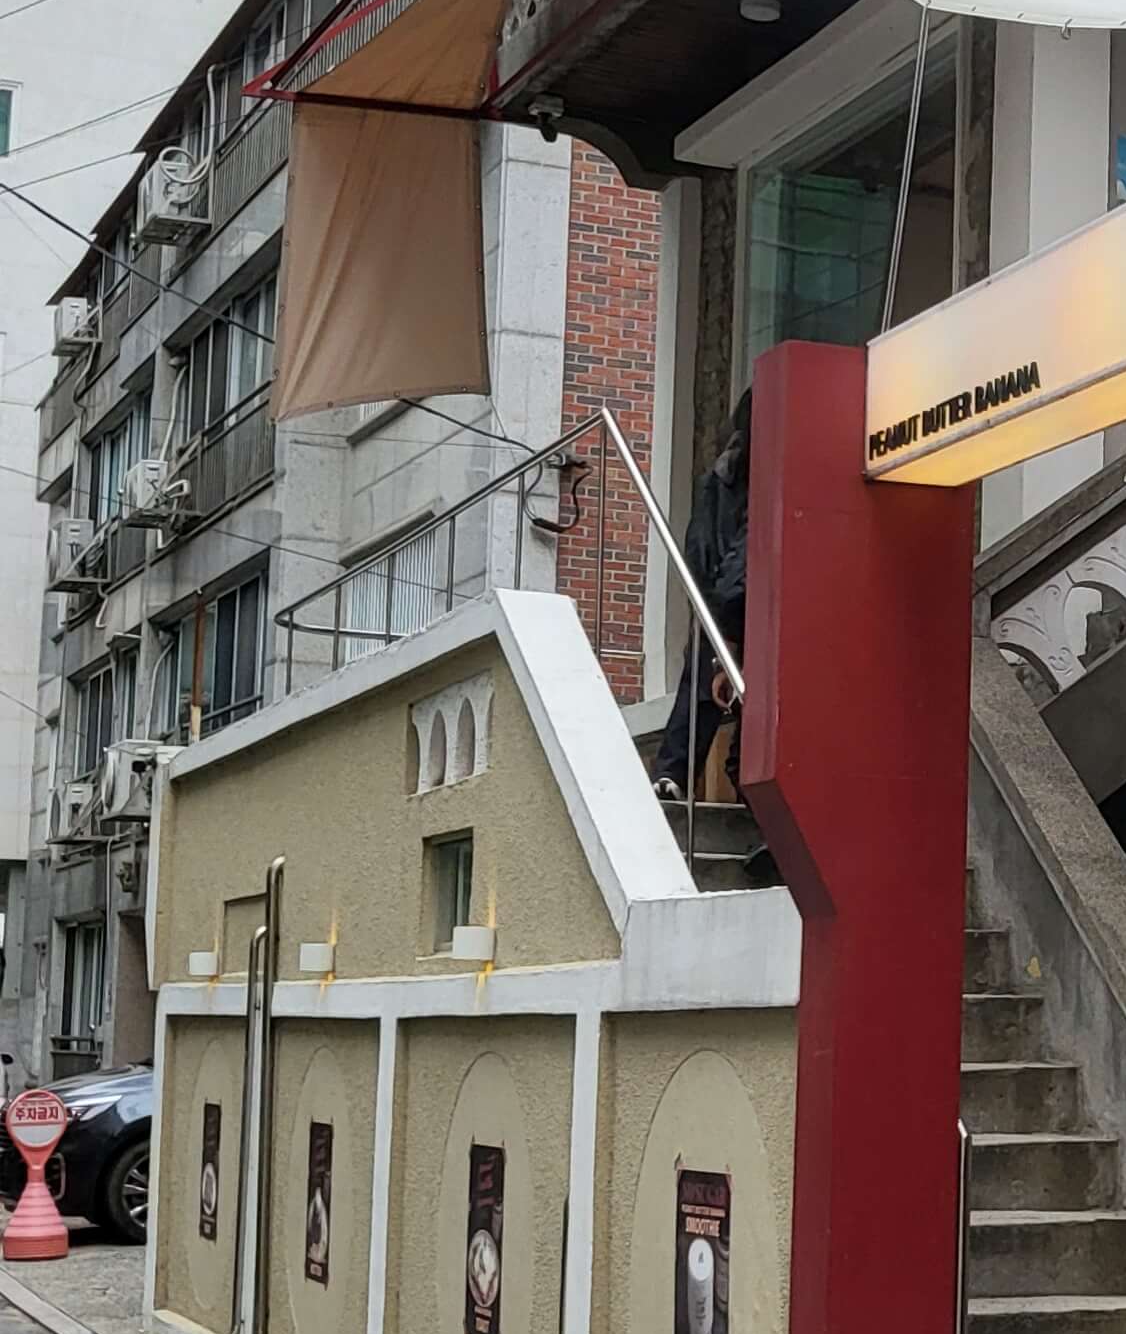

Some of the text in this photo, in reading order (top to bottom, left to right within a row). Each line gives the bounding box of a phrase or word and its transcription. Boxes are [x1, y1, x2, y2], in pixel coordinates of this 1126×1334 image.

[868, 361, 1041, 460] PEANUT BUTTER BANANA
[15, 1106, 59, 1121] 주차금지
